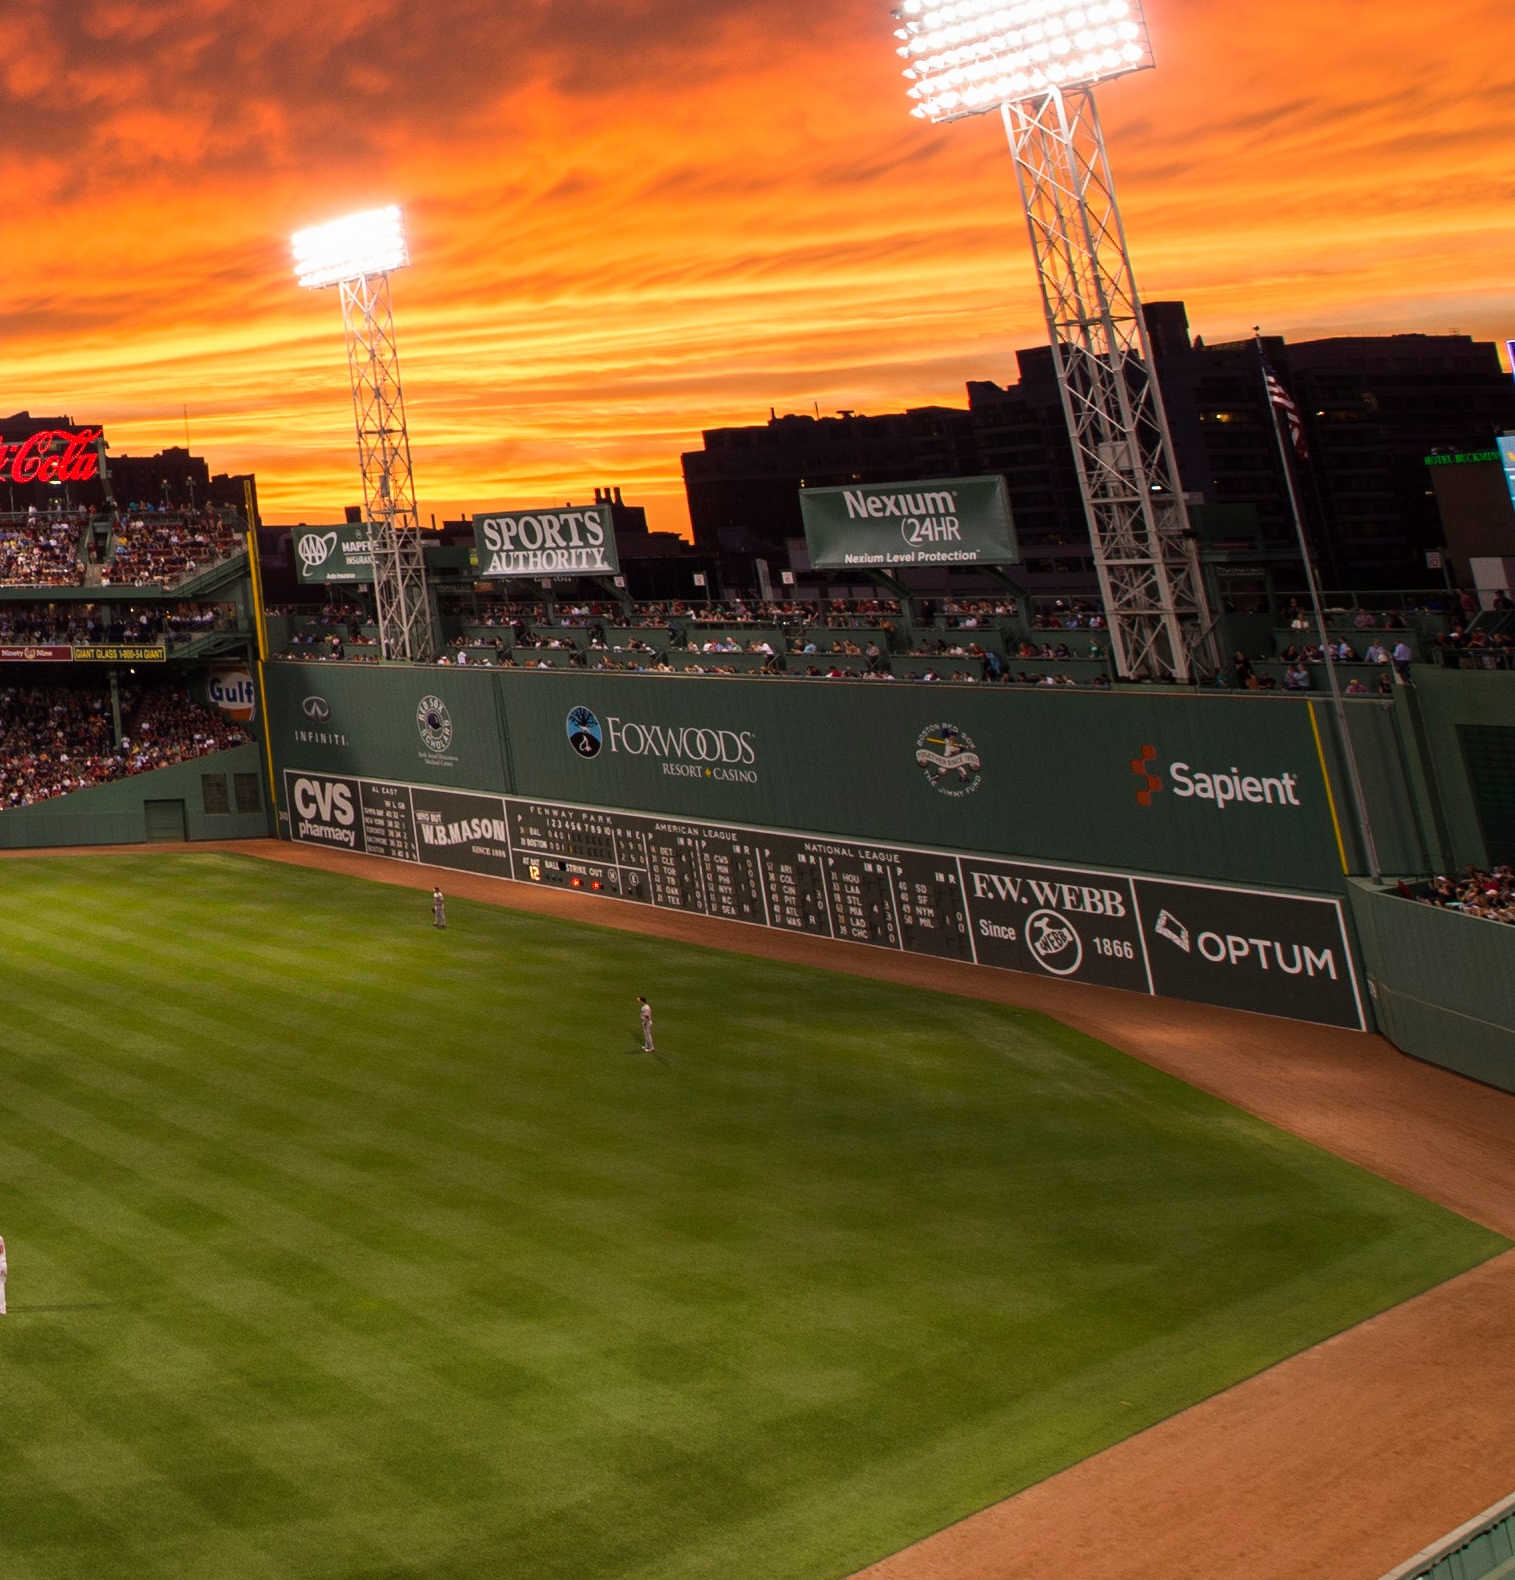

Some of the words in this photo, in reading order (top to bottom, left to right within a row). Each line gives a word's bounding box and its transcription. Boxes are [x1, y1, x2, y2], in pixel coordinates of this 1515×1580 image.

[843, 490, 957, 519] Nexium
[483, 510, 605, 553] SPORTS
[488, 548, 605, 573] AUTHORITY
[844, 553, 884, 564] Nexium
[886, 551, 915, 563] Level
[917, 549, 977, 562] Protection
[36, 649, 53, 658] Nine
[75, 648, 95, 659] GIANT
[96, 648, 117, 659] GLASS
[143, 648, 164, 659] GIANT
[210, 677, 253, 704] Gulf
[295, 730, 348, 746] INFINITI
[606, 716, 756, 765] FOXWOODS
[662, 763, 704, 779] RESORT
[713, 767, 758, 783] CASINO
[1169, 761, 1300, 808] Sapient
[294, 778, 355, 826] CVS
[530, 805, 574, 818] FENWAY
[582, 812, 613, 824] PARK
[299, 820, 356, 848] pharmacy
[655, 823, 699, 836] AMERICAN
[702, 829, 738, 842] LEAGUE
[804, 842, 855, 858] NATIONAL
[858, 850, 901, 863] LEAGUE
[979, 919, 1016, 942] Since
[1093, 937, 1134, 960] 1866
[1197, 931, 1338, 980] OPTUM
